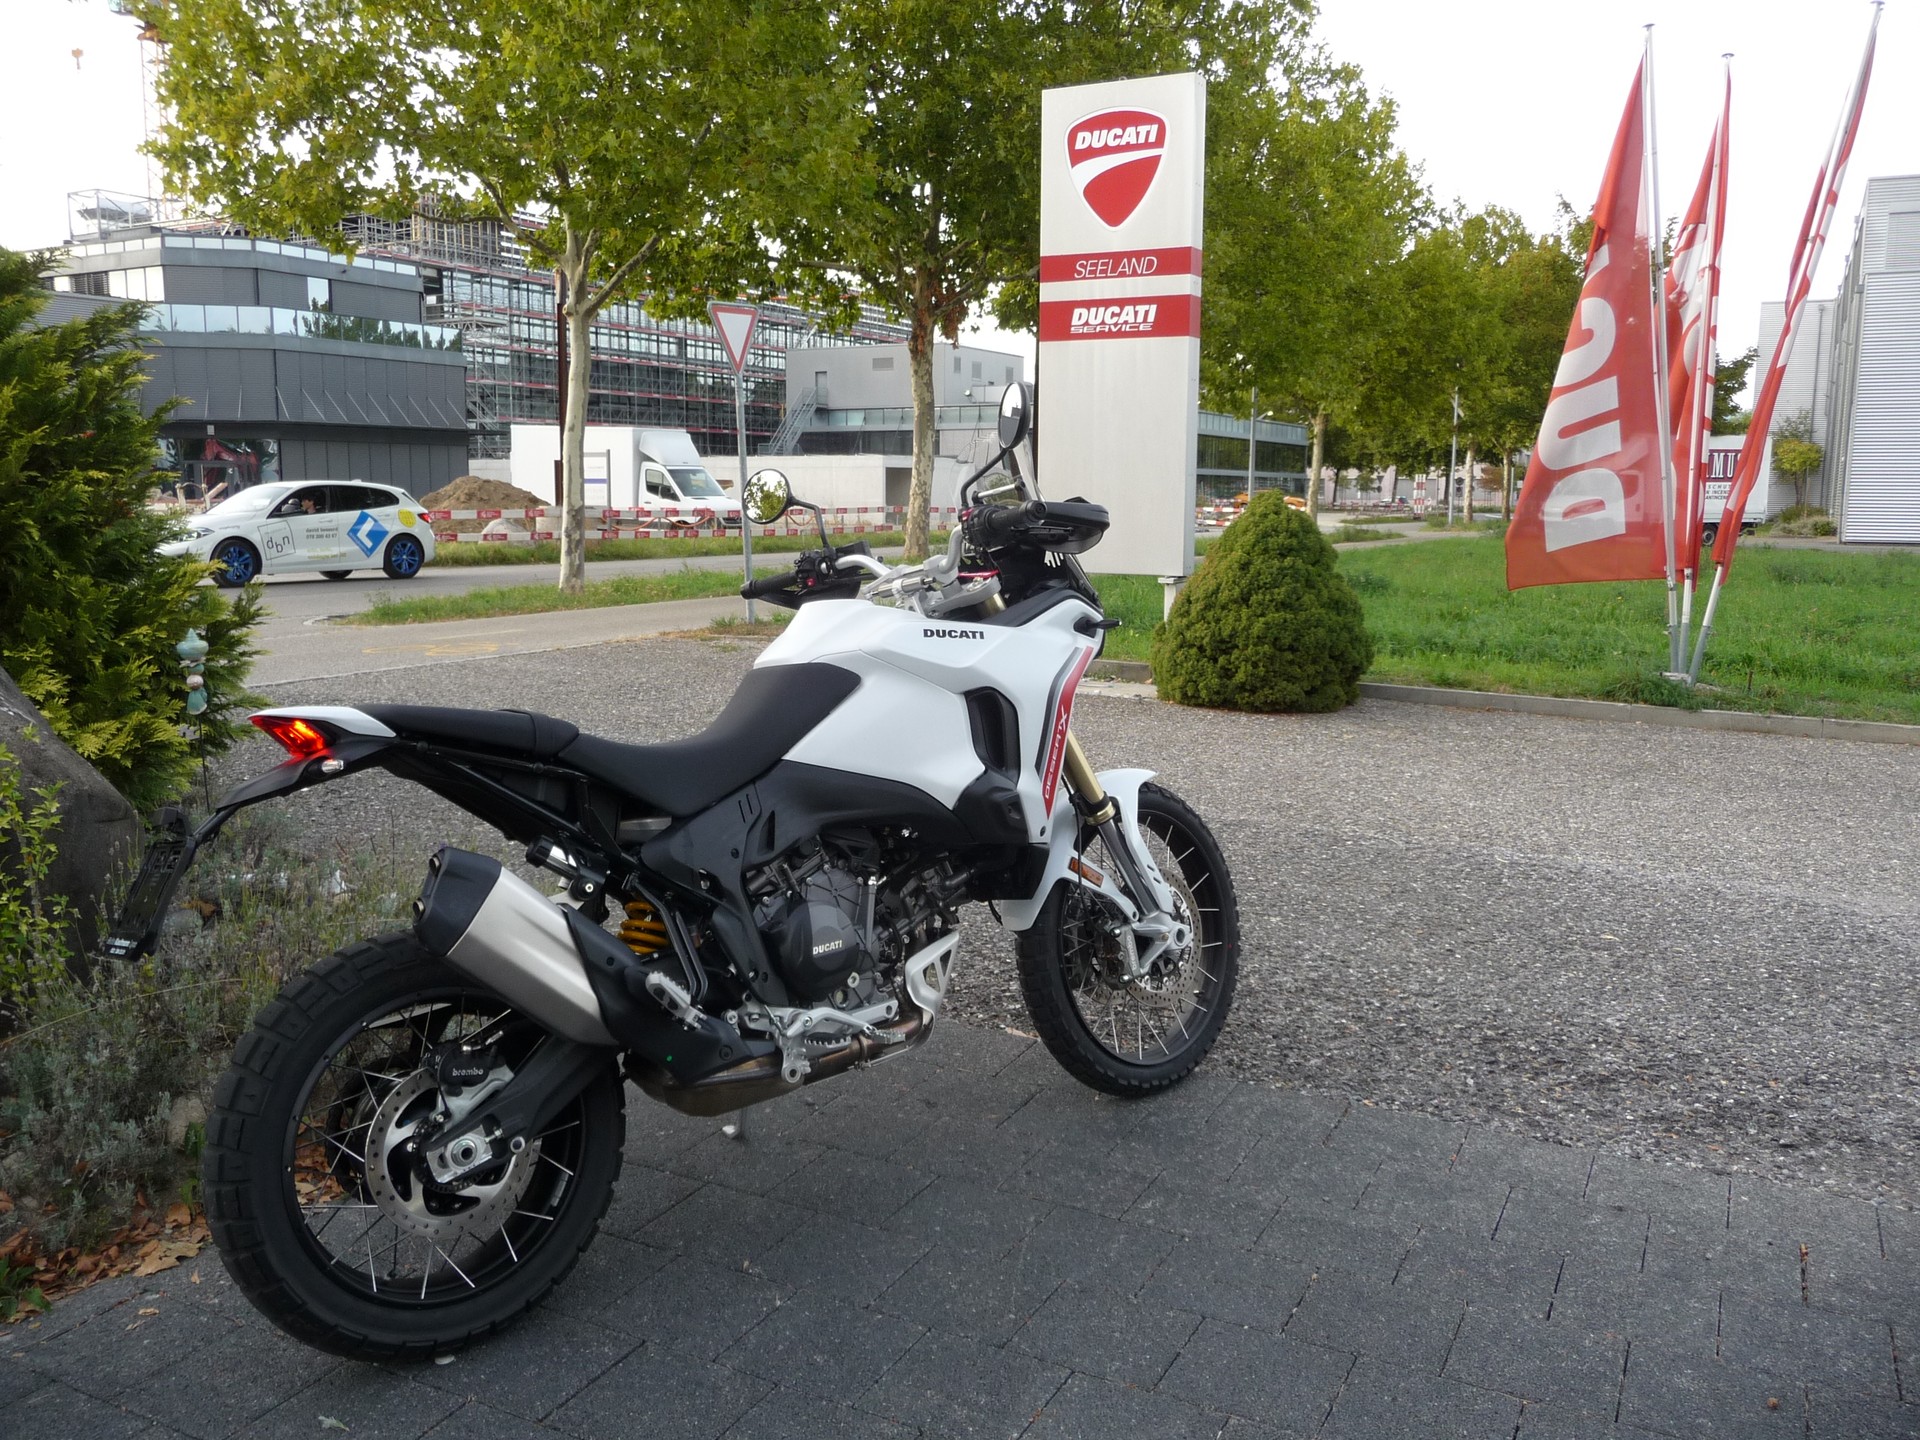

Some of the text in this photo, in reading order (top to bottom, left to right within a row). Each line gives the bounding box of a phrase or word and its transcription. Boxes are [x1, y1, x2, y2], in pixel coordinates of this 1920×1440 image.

[1074, 123, 1159, 150] DUCATI
[1074, 255, 1158, 279] SEELAND
[1071, 304, 1158, 326] DUCATI
[1070, 322, 1154, 334] SERVICE
[922, 628, 985, 640] DUCATI
[812, 939, 843, 955] DUCATI
[452, 1067, 484, 1077] brembo
